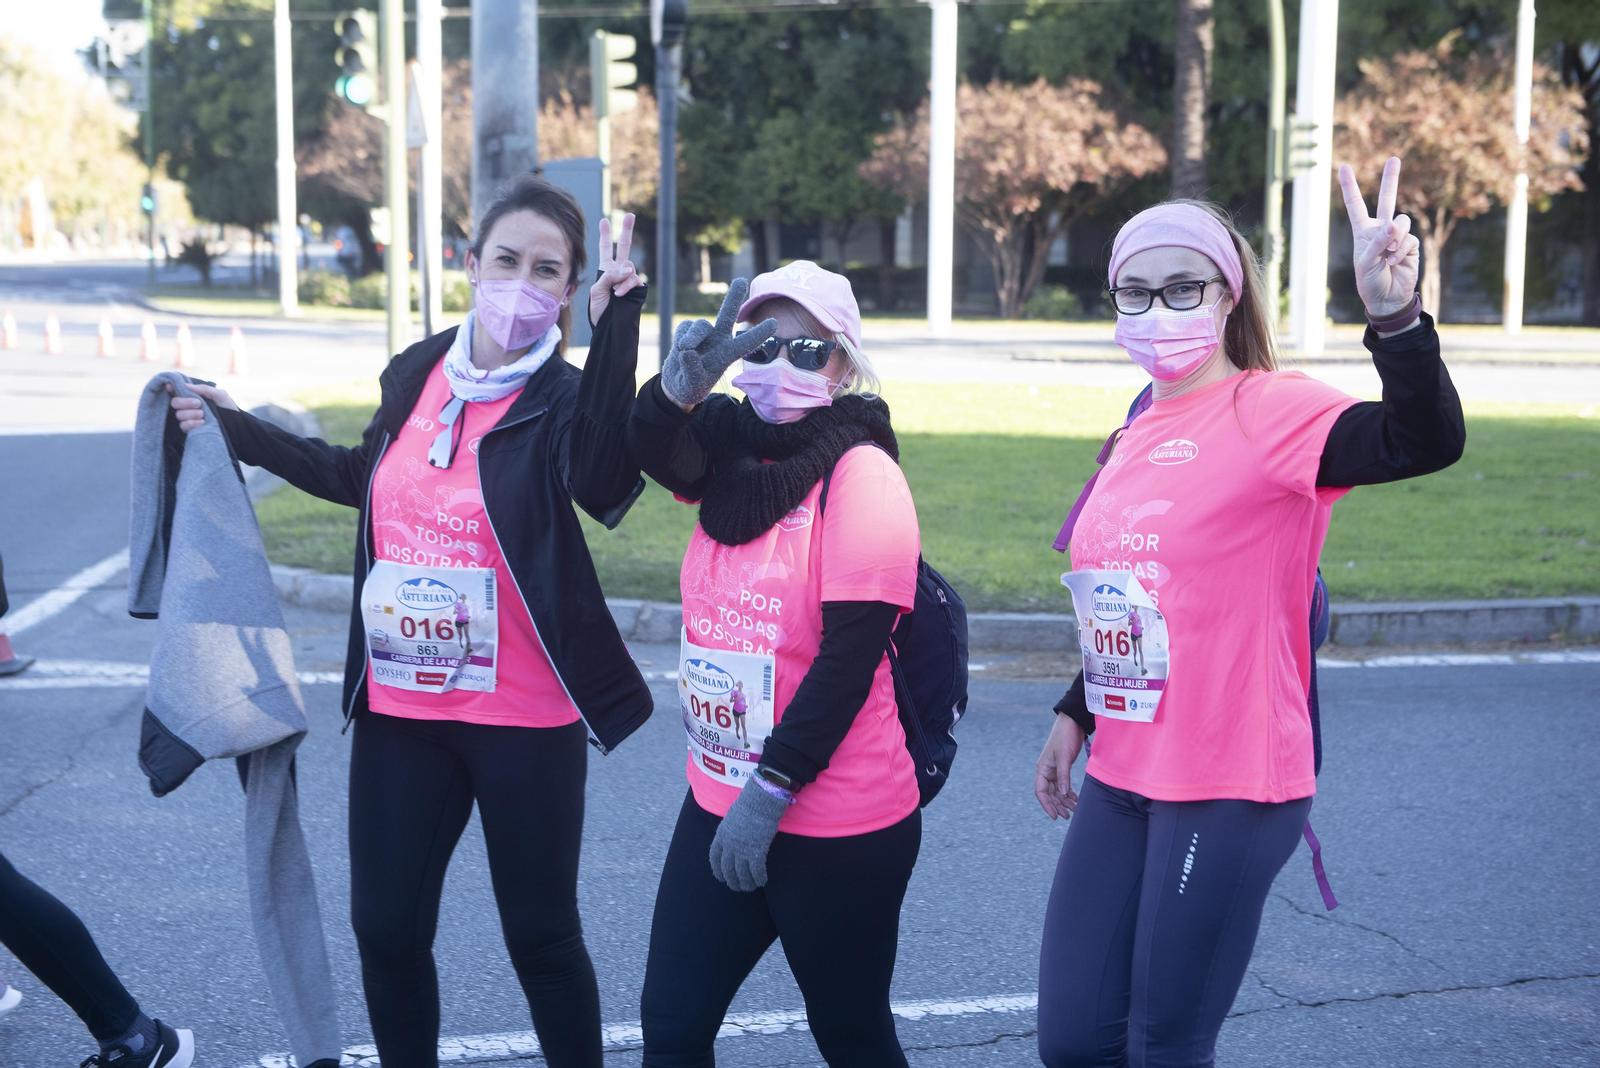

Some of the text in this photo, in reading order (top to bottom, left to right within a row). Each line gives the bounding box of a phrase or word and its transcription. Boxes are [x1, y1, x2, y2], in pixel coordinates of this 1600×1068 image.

[1151, 449, 1193, 460] ASTURIANA
[437, 512, 480, 535] POR
[415, 525, 478, 556] TODAS
[1121, 533, 1160, 552] POR
[400, 587, 454, 603] ASTURIANA
[740, 589, 782, 616] POR
[1093, 597, 1128, 613] ASTURIANA
[400, 616, 455, 641] 016
[717, 605, 778, 641] TODAS
[417, 645, 439, 656] 863
[1095, 628, 1130, 657] 016
[391, 653, 422, 665] CARRERA
[425, 658, 434, 666] DE
[436, 658, 446, 666] LA
[1102, 661, 1120, 676] 3591
[376, 666, 411, 681] OYSHO
[460, 673, 486, 682] ZURICH
[687, 664, 730, 690] ASTURIANA
[1108, 677, 1116, 687] DE
[1116, 679, 1124, 688] LA
[1124, 679, 1148, 689] MUJER
[690, 693, 732, 729] 016
[699, 725, 720, 744] 2869
[706, 743, 714, 752] DE
[714, 745, 723, 755] LA
[724, 748, 750, 761] MUJER
